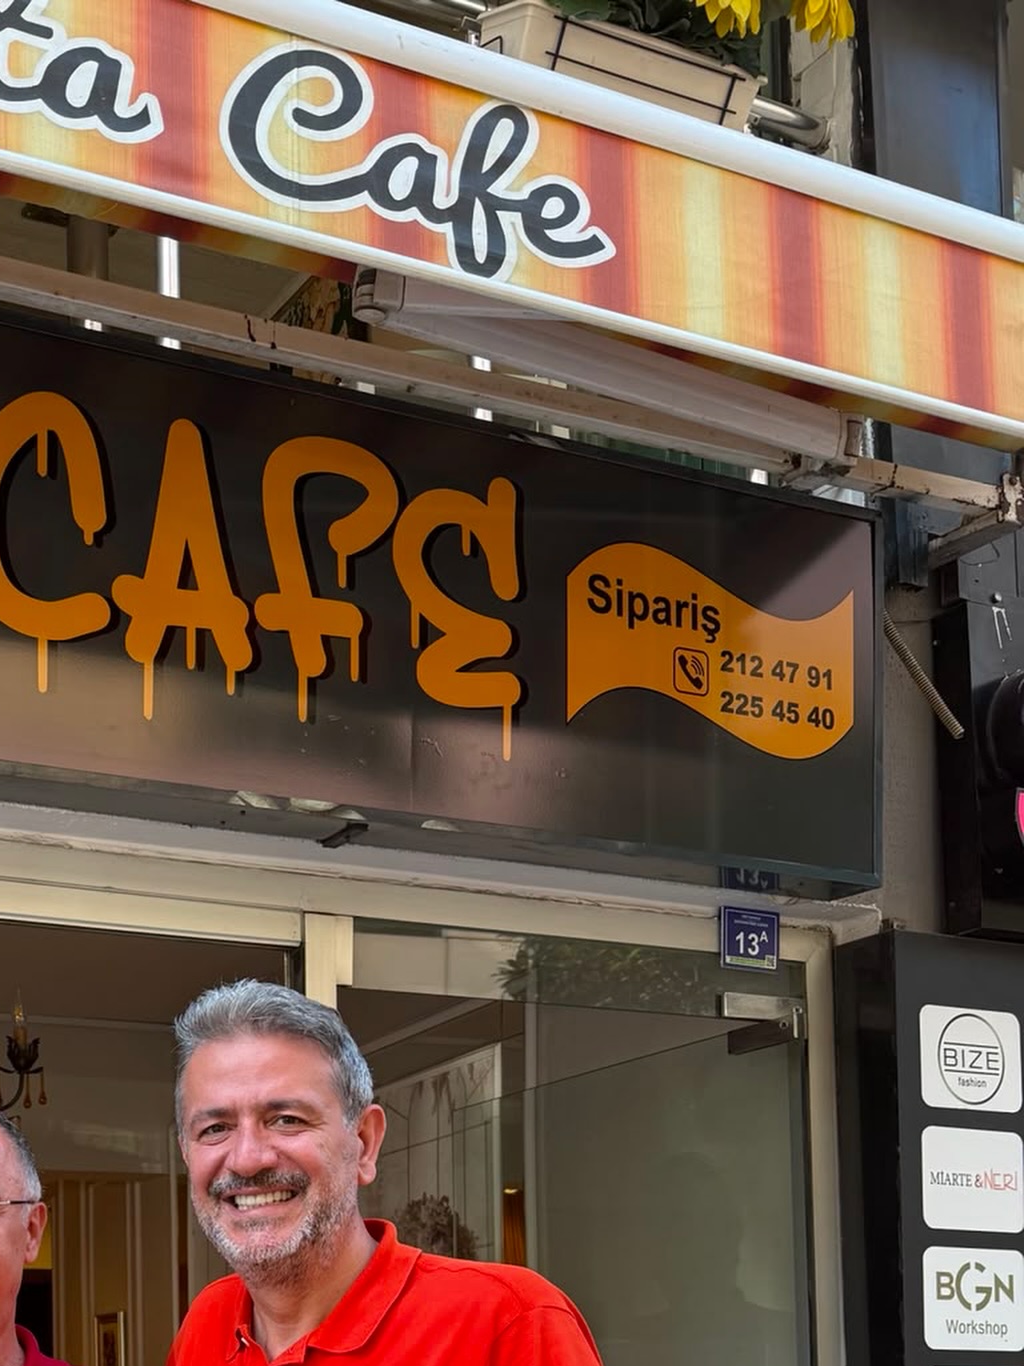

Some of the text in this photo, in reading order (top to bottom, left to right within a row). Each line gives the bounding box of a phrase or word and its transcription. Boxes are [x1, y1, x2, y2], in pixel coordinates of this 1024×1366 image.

[230, 50, 605, 276] Cafe
[587, 573, 721, 643] Sipariş
[719, 650, 833, 690] 212 47 91
[719, 691, 835, 730] 225 45 40
[943, 1047, 1000, 1071] BIZE
[958, 1077, 987, 1088] fashion
[936, 1262, 1014, 1311] BGN
[945, 1319, 1008, 1338] Workshop
